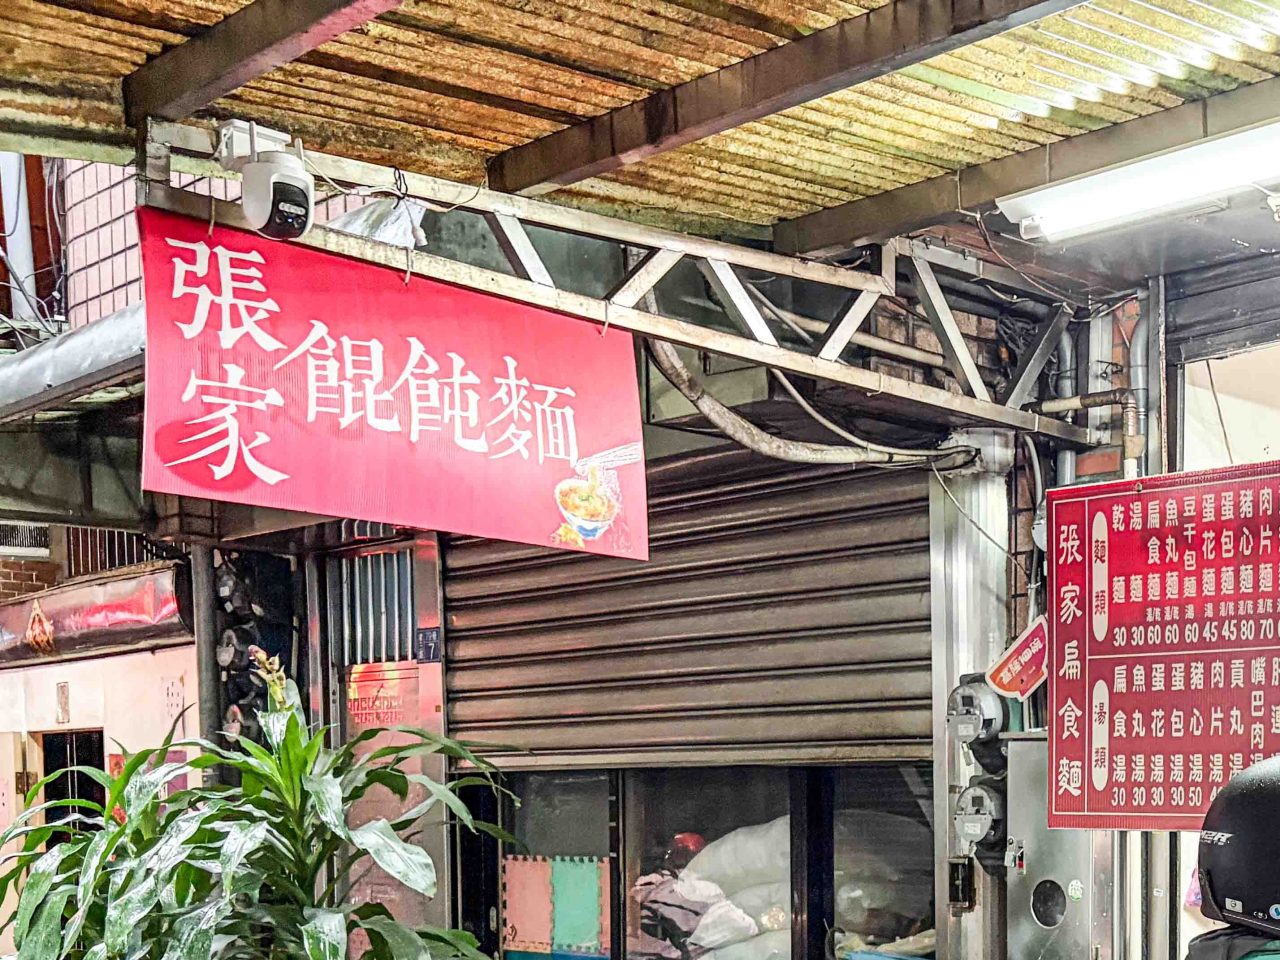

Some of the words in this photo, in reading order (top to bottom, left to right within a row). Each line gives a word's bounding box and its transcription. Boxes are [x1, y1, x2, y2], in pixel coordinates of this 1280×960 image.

[163, 236, 290, 485] 張家
[273, 319, 579, 466] 餛飩麵
[1112, 504, 1125, 603] 乾麵
[1130, 501, 1143, 602] 湯麵
[1147, 500, 1160, 601] 扁食麵
[1165, 498, 1179, 599] 魚丸麵
[1183, 496, 1197, 598] 豆干包麵
[1202, 494, 1215, 597] 蛋花麵
[1221, 492, 1234, 595] 蛋包麵
[1239, 489, 1253, 593] 豬心麵
[1259, 487, 1273, 592] 肉片麵
[1058, 524, 1082, 798] 張家扁食麵
[1113, 627, 1126, 646] 30
[1131, 626, 1144, 645] 30
[1148, 625, 1161, 644] 60
[1165, 624, 1179, 643] 60
[1185, 623, 1199, 642] 60
[1203, 622, 1218, 641] 45
[1222, 620, 1237, 640] 45
[1241, 620, 1255, 640] 80
[1259, 618, 1274, 638] 70
[1094, 702, 1106, 768] 湯類
[1113, 665, 1127, 782] 扁食湯
[1132, 664, 1145, 782] 魚丸湯
[1151, 663, 1165, 782] 蛋花湯
[1170, 663, 1184, 782] 蛋包湯
[1189, 661, 1204, 782] 豬心湯
[1209, 659, 1224, 782] 肉片湯
[1229, 659, 1244, 781] 貢丸湯
[1112, 787, 1126, 806] 30
[1132, 787, 1145, 806] 30
[1151, 787, 1164, 806] 30
[1171, 786, 1184, 806] 30
[1189, 787, 1202, 806] 50
